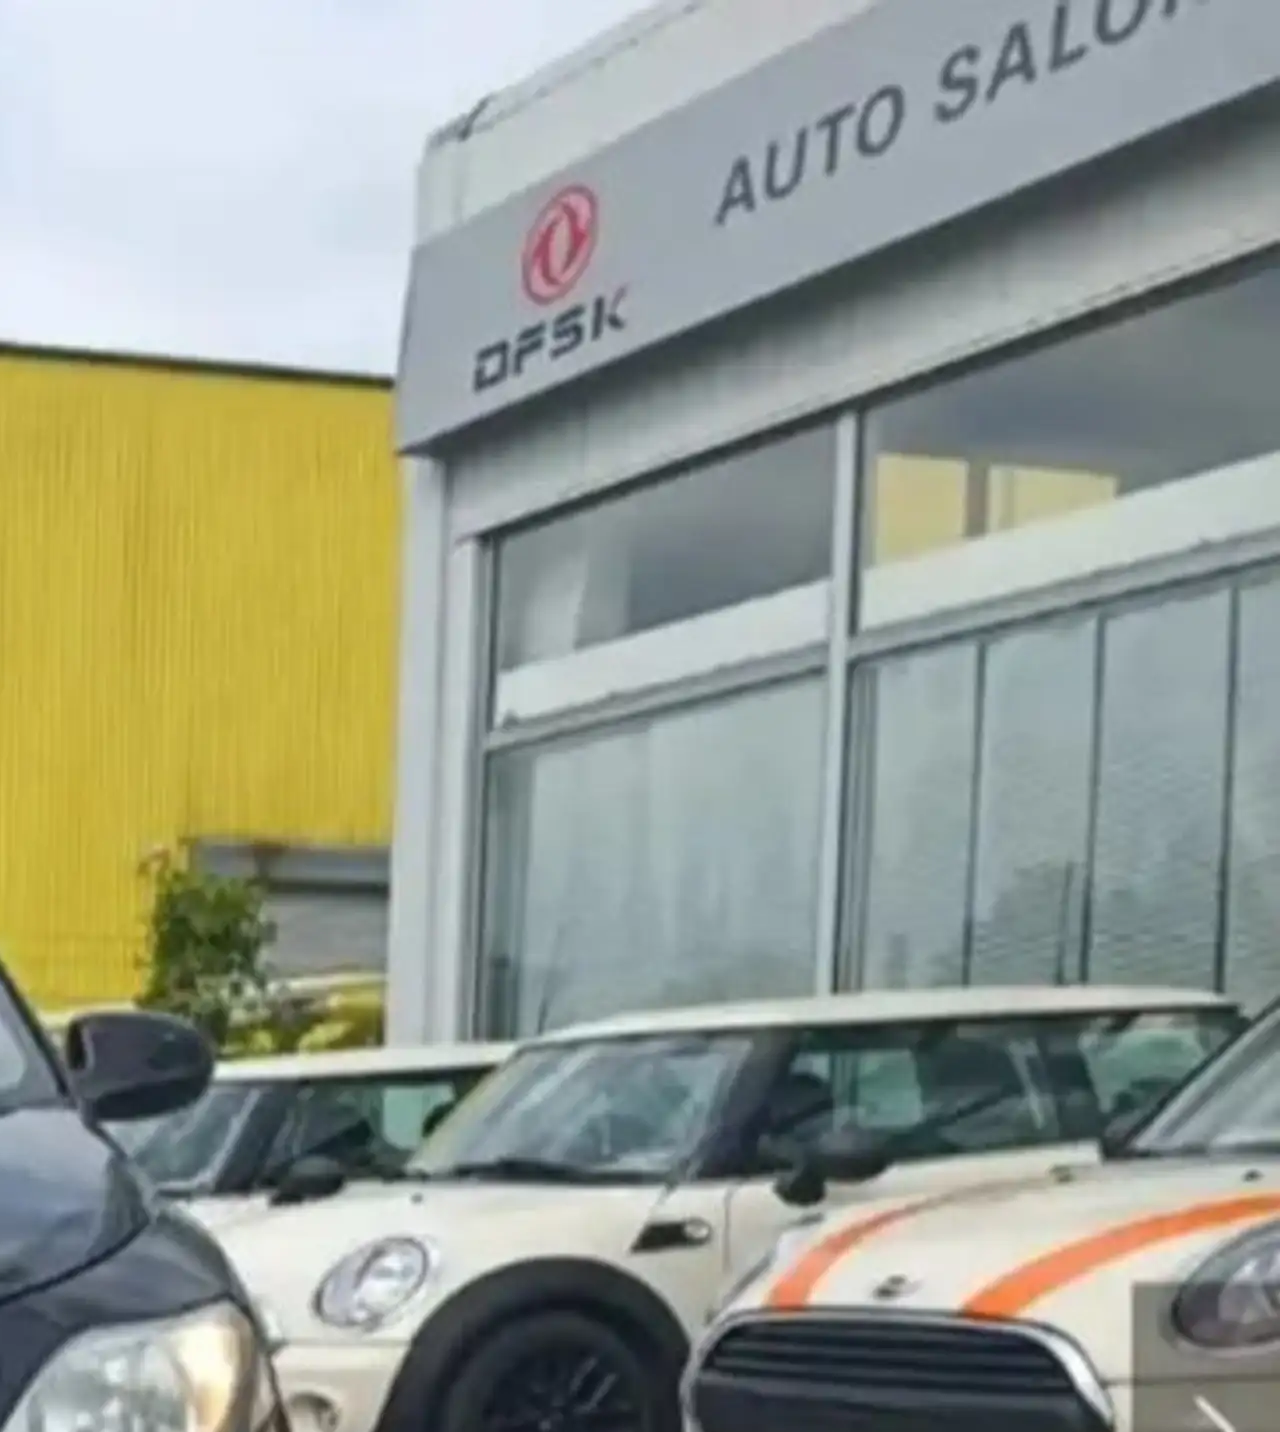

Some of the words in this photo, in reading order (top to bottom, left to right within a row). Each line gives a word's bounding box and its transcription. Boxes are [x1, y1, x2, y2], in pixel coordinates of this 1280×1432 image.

[714, 84, 905, 226] AUTO
[933, 0, 1210, 122] SALO
[472, 285, 628, 393] DFSK
